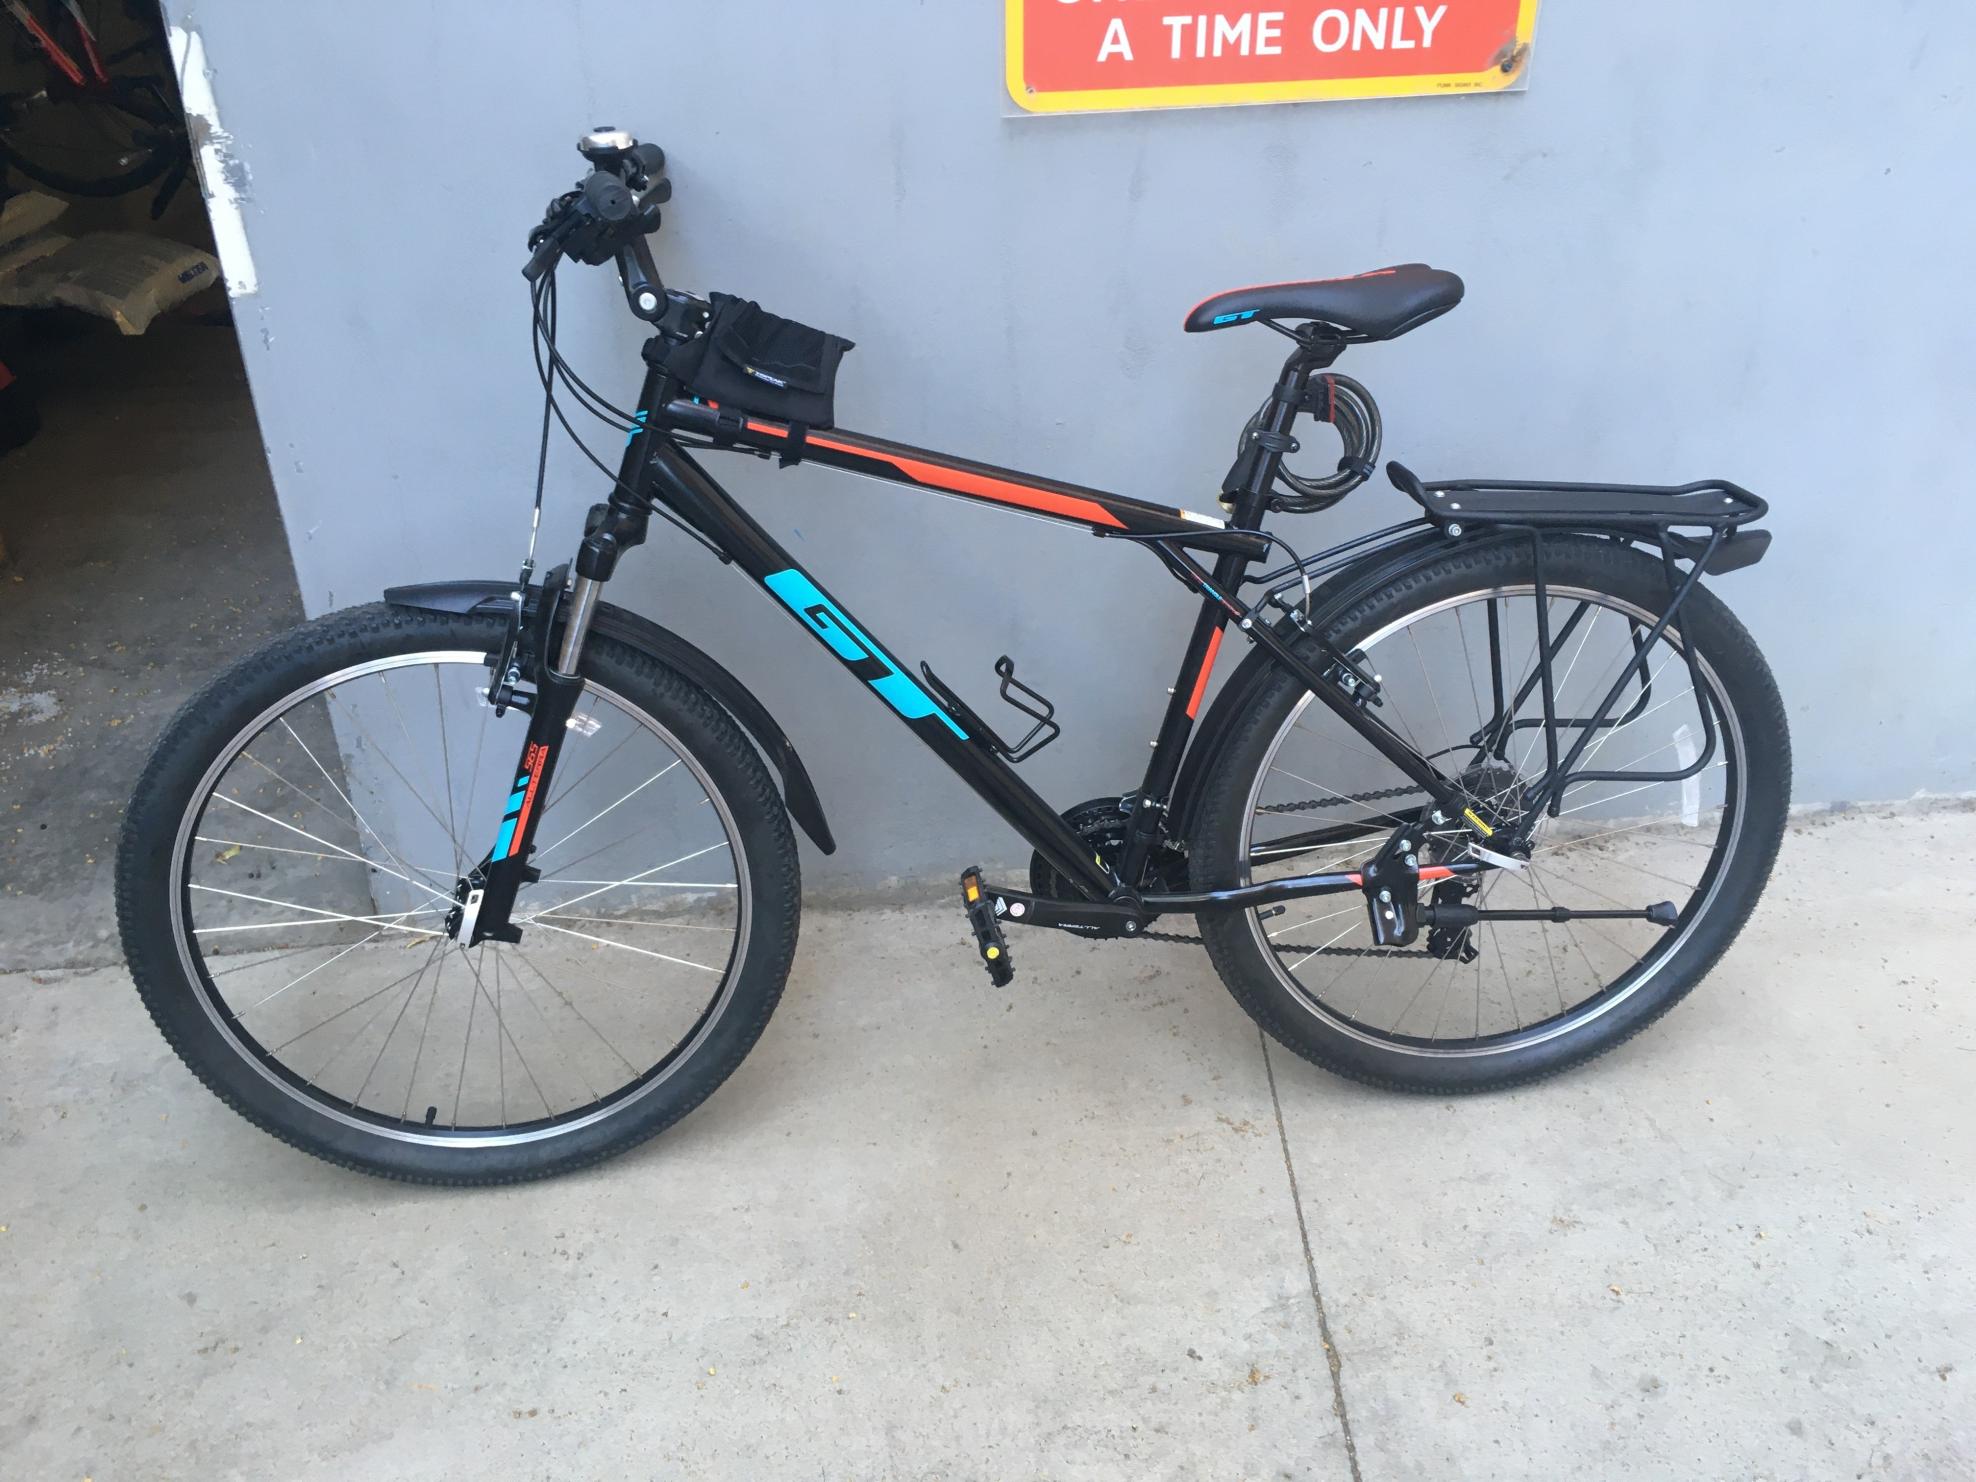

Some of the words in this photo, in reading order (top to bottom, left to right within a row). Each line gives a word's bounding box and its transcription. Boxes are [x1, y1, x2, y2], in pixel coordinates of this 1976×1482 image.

[1097, 18, 1134, 62] A
[1162, 12, 1284, 59] TIME
[1312, 5, 1448, 53] ONLY
[1213, 309, 1260, 324] GT
[764, 568, 970, 741] GT
